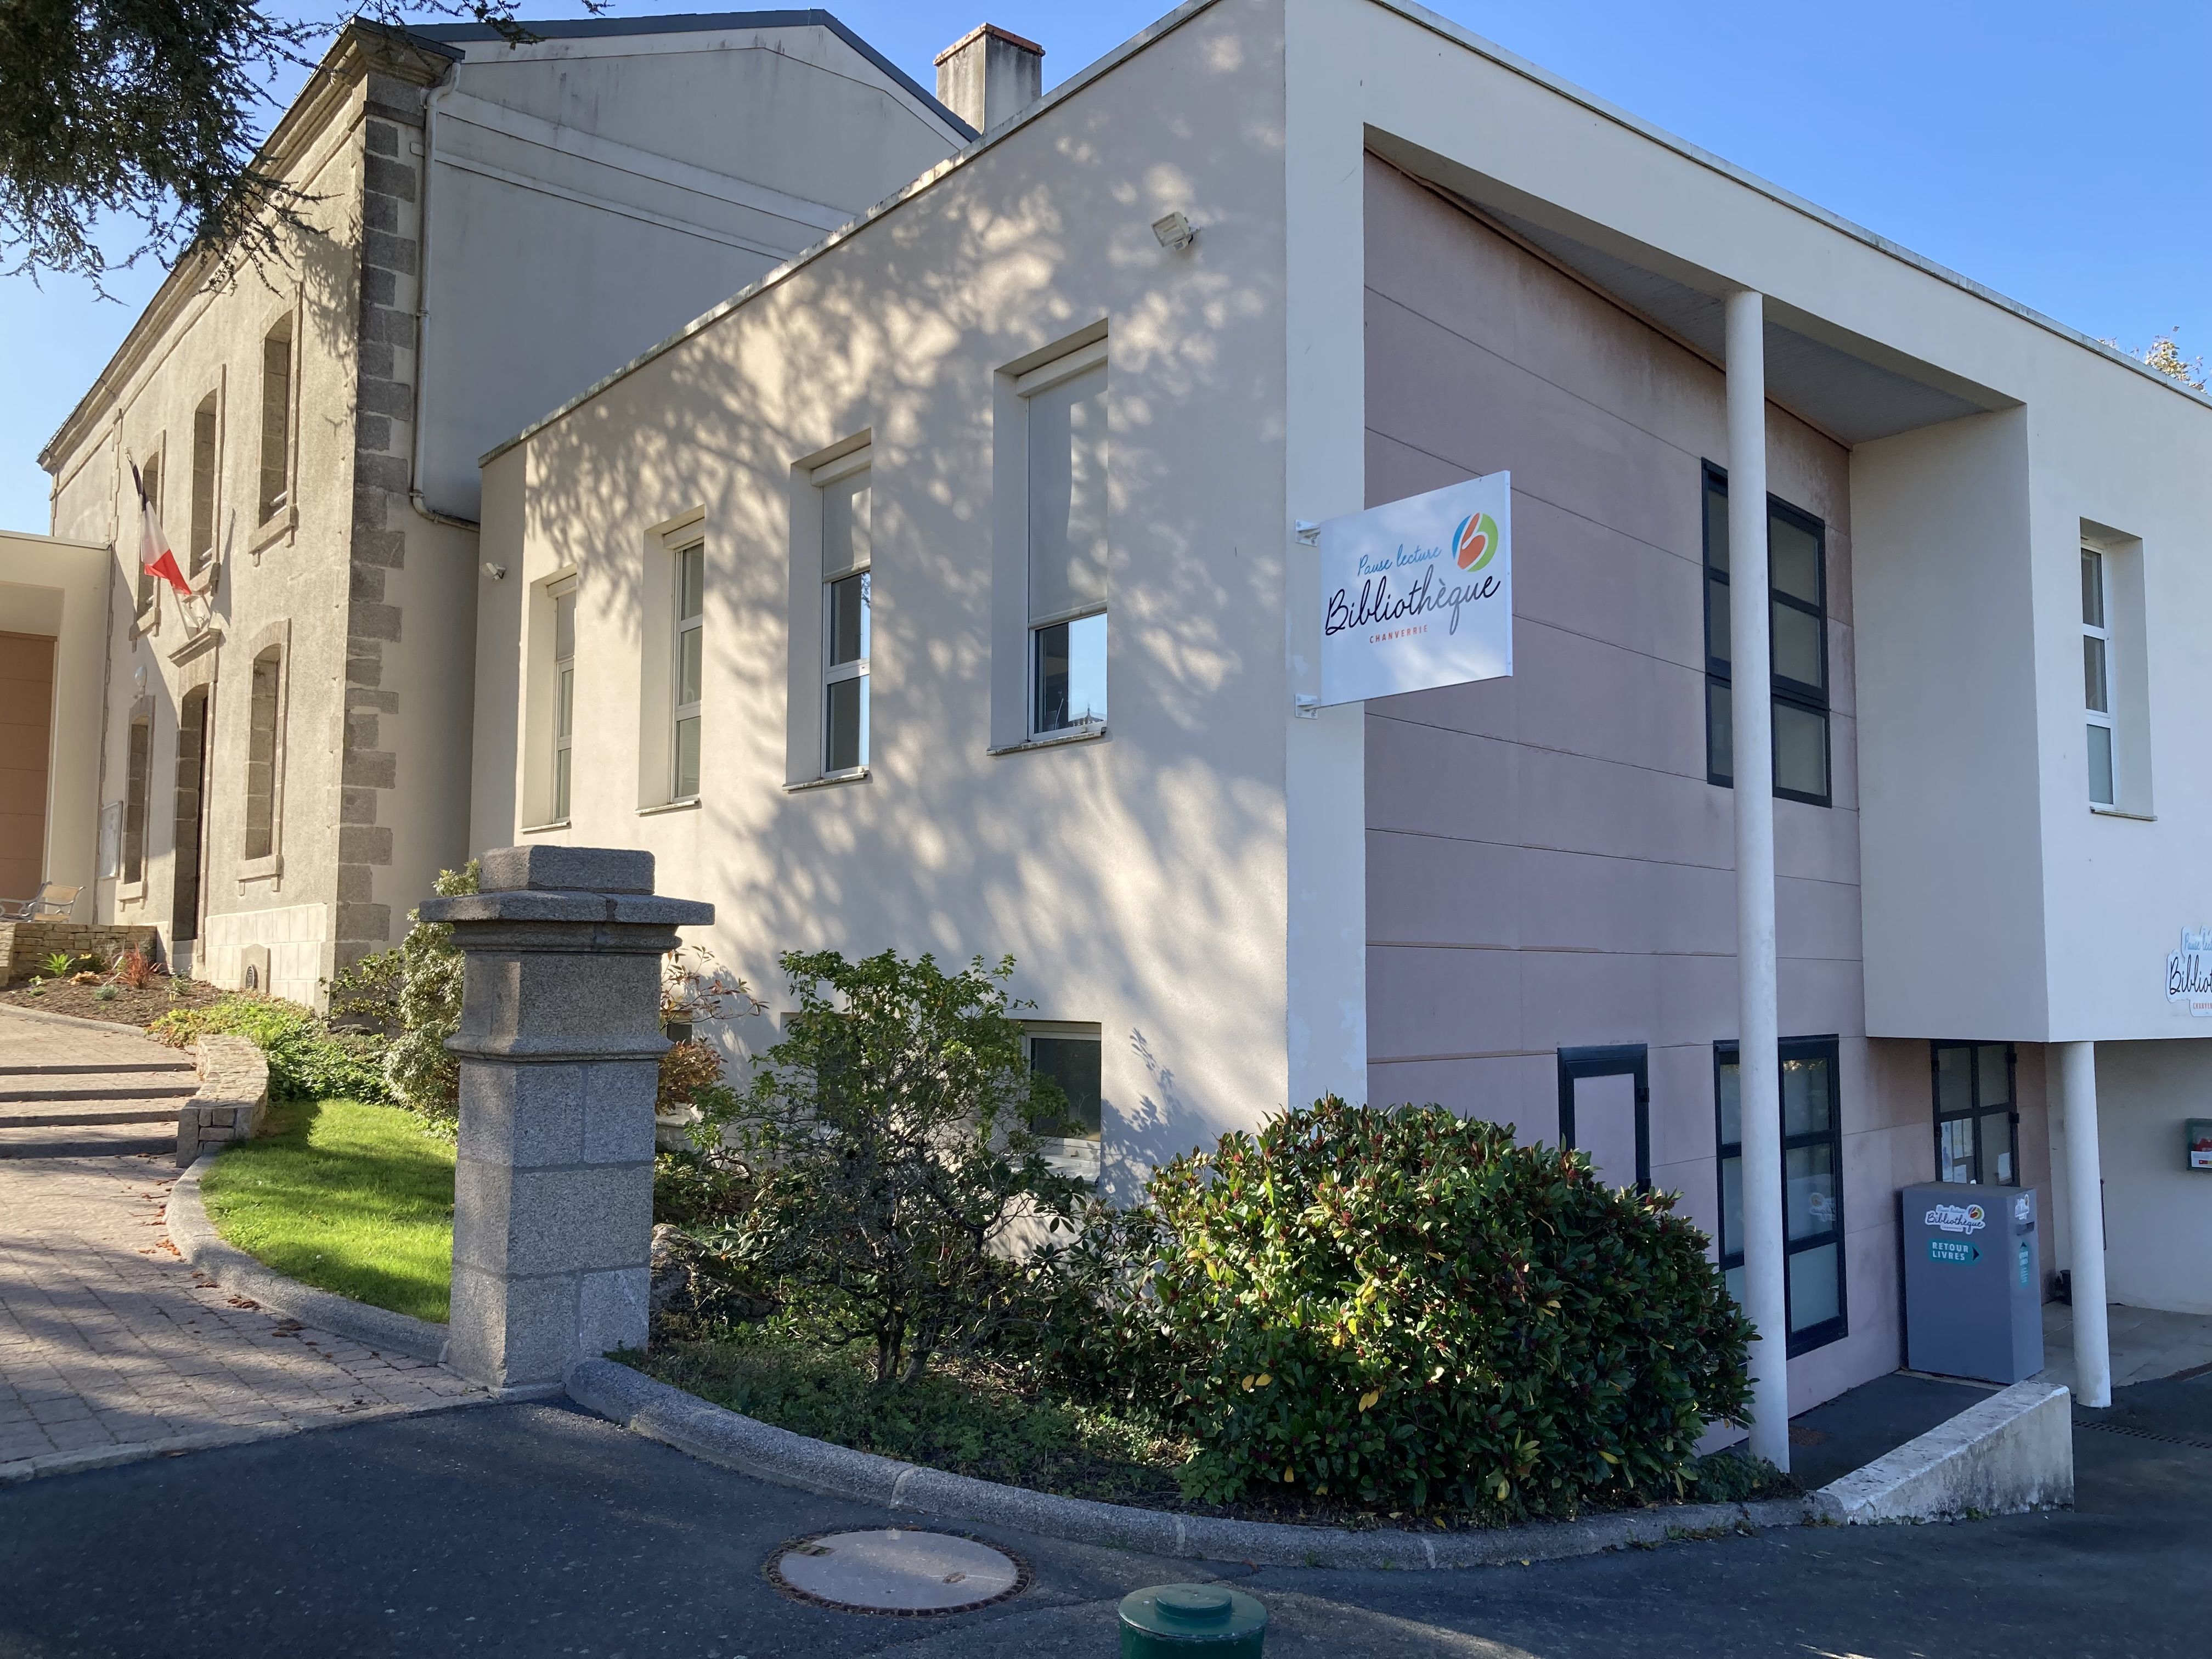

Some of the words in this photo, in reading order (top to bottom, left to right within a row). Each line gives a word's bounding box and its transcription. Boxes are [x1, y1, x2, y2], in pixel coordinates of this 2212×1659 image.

[1357, 554, 1393, 577] Pause
[1396, 544, 1442, 566] lecture
[1325, 564, 1501, 636] Bibliothèque
[1369, 624, 1428, 644] CHANVERRIE
[1927, 1212, 1983, 1232] Bibliothèque
[1932, 1242, 1968, 1252] RETOUR
[1933, 1250, 1965, 1261] LIVRES
